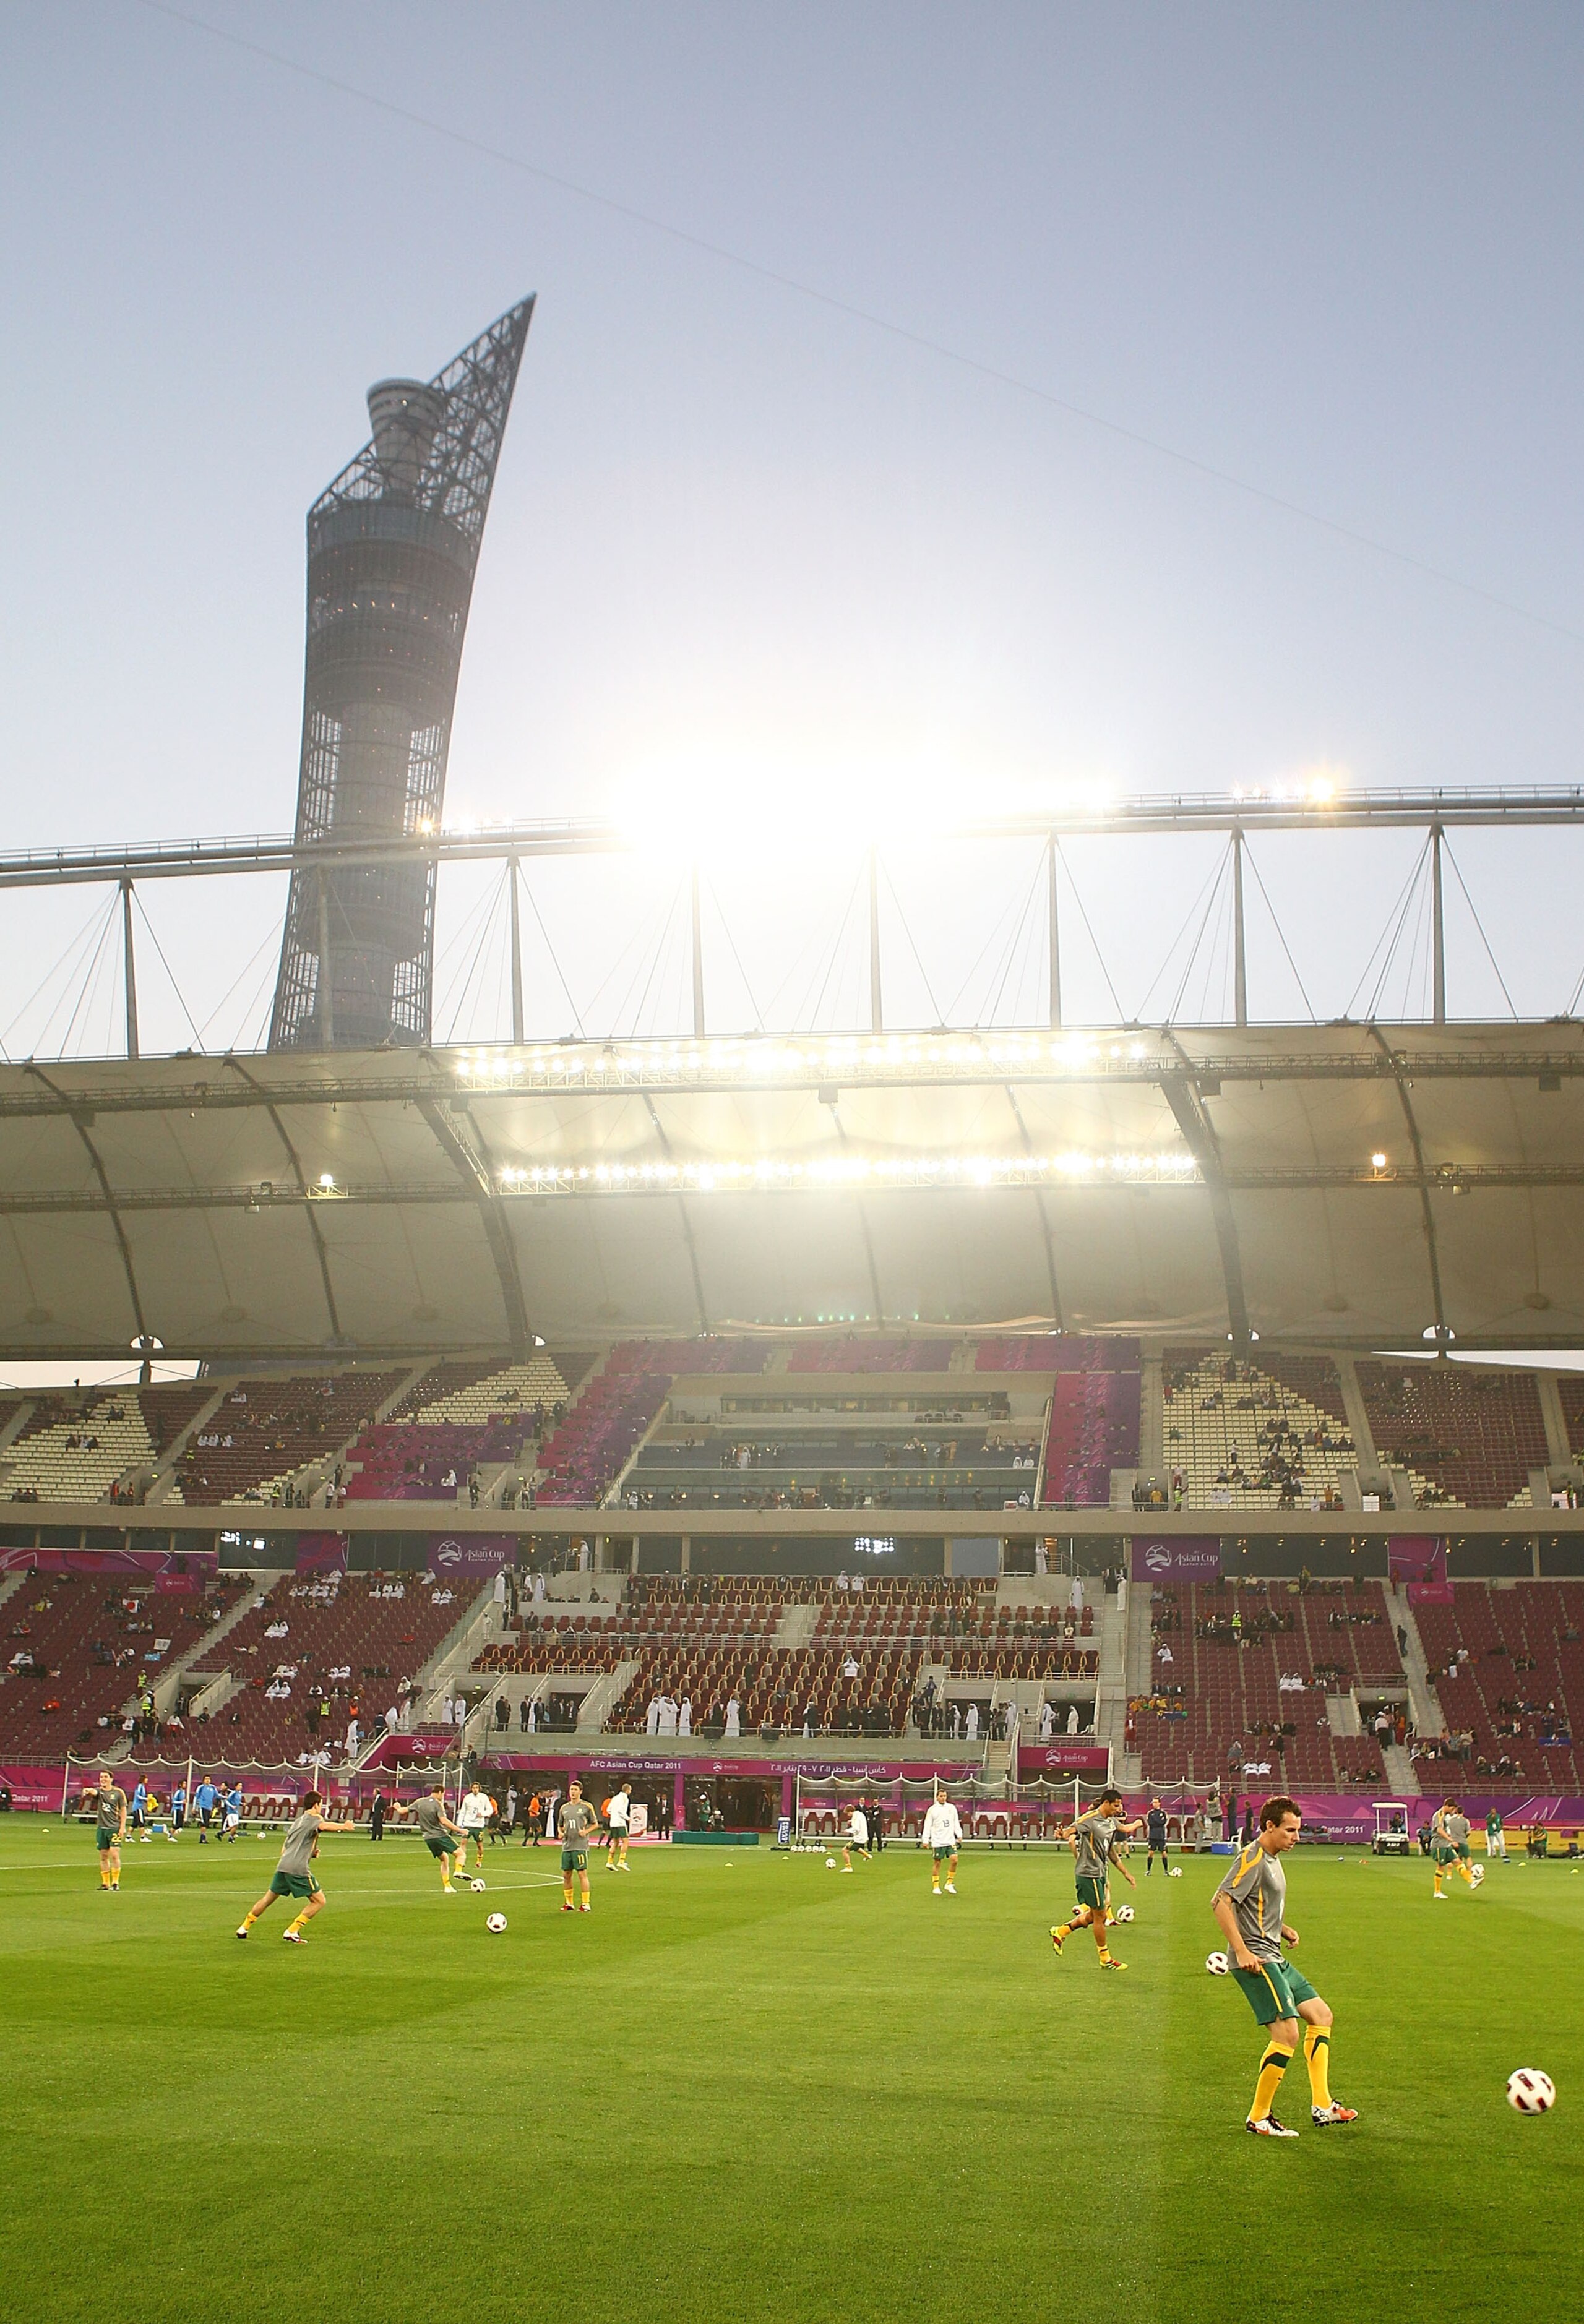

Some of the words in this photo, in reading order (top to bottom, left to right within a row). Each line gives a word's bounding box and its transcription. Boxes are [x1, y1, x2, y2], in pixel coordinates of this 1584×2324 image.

[464, 1549, 488, 1561] Asian
[489, 1549, 505, 1562] Cup
[1174, 1553, 1200, 1566] Asian
[1201, 1553, 1218, 1566] Cup
[628, 1761, 643, 1769] Cup
[101, 1802, 111, 1812] 22
[569, 1819, 576, 1829] 11
[1345, 1825, 1364, 1833] 2011
[577, 1854, 585, 1864] 11
